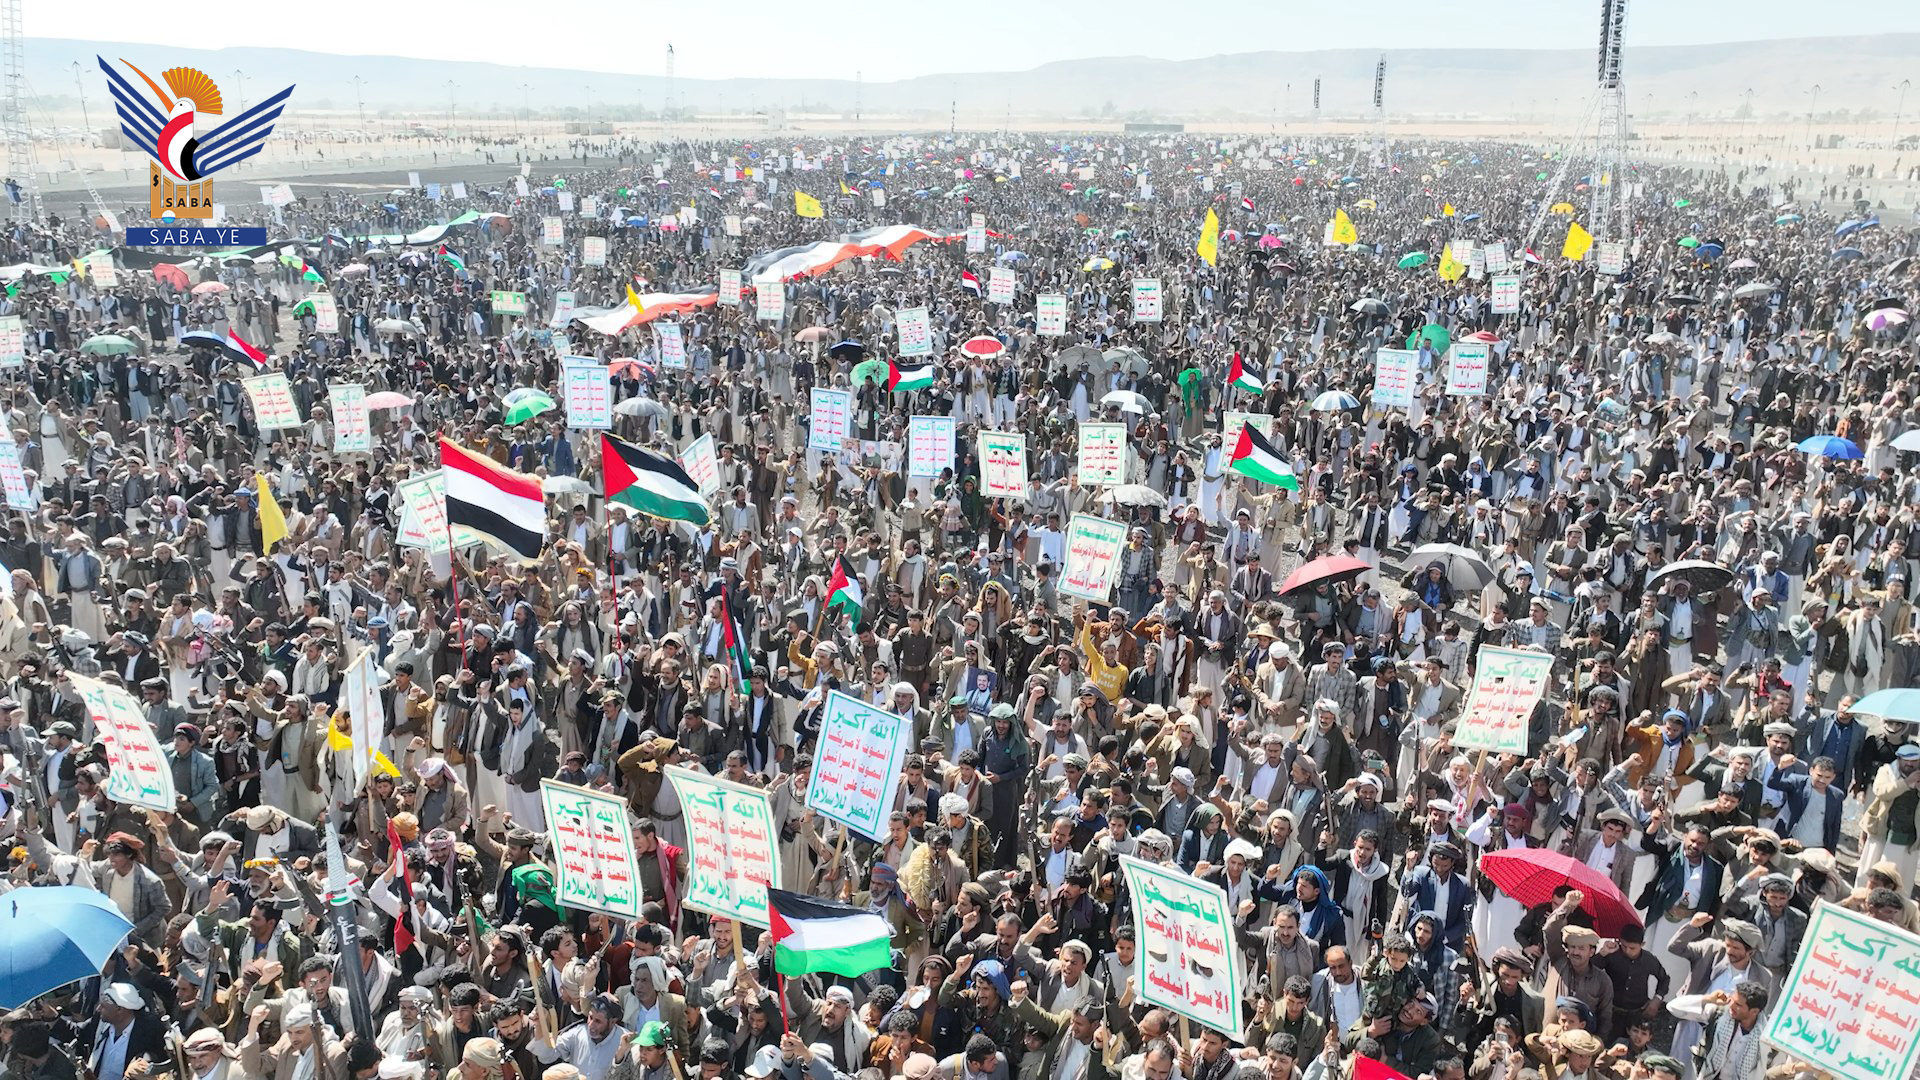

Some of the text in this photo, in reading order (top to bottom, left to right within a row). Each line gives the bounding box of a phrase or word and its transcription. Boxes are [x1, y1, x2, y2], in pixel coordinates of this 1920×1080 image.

[1075, 523, 1119, 543] قاطعوا
[832, 710, 895, 741] الله أكبر
[862, 744, 890, 762] الموت
[857, 763, 886, 781] الموت
[818, 769, 882, 801] اللعنة على اليهود
[556, 799, 621, 824] الله أكبر
[685, 787, 763, 820] الله أكبر
[846, 802, 876, 822] النصر
[595, 831, 624, 844] الموت
[728, 823, 768, 842] الموت
[598, 850, 628, 863] الموت
[731, 844, 770, 864] الموت
[602, 886, 633, 907] النصر
[734, 888, 767, 911] لنصر
[1135, 876, 1219, 925] قاطعوا
[1144, 909, 1224, 957] البضائع الأمريكية
[1820, 928, 1898, 962] أكبر
[1180, 952, 1186, 970] و
[1148, 964, 1229, 1015] الإسرائيلية
[1802, 968, 1918, 1033] الموت لإسرائيل
[1792, 992, 1907, 1055] اللعنة على اليهود
[1780, 1015, 1897, 1079] النصر للإسلام
